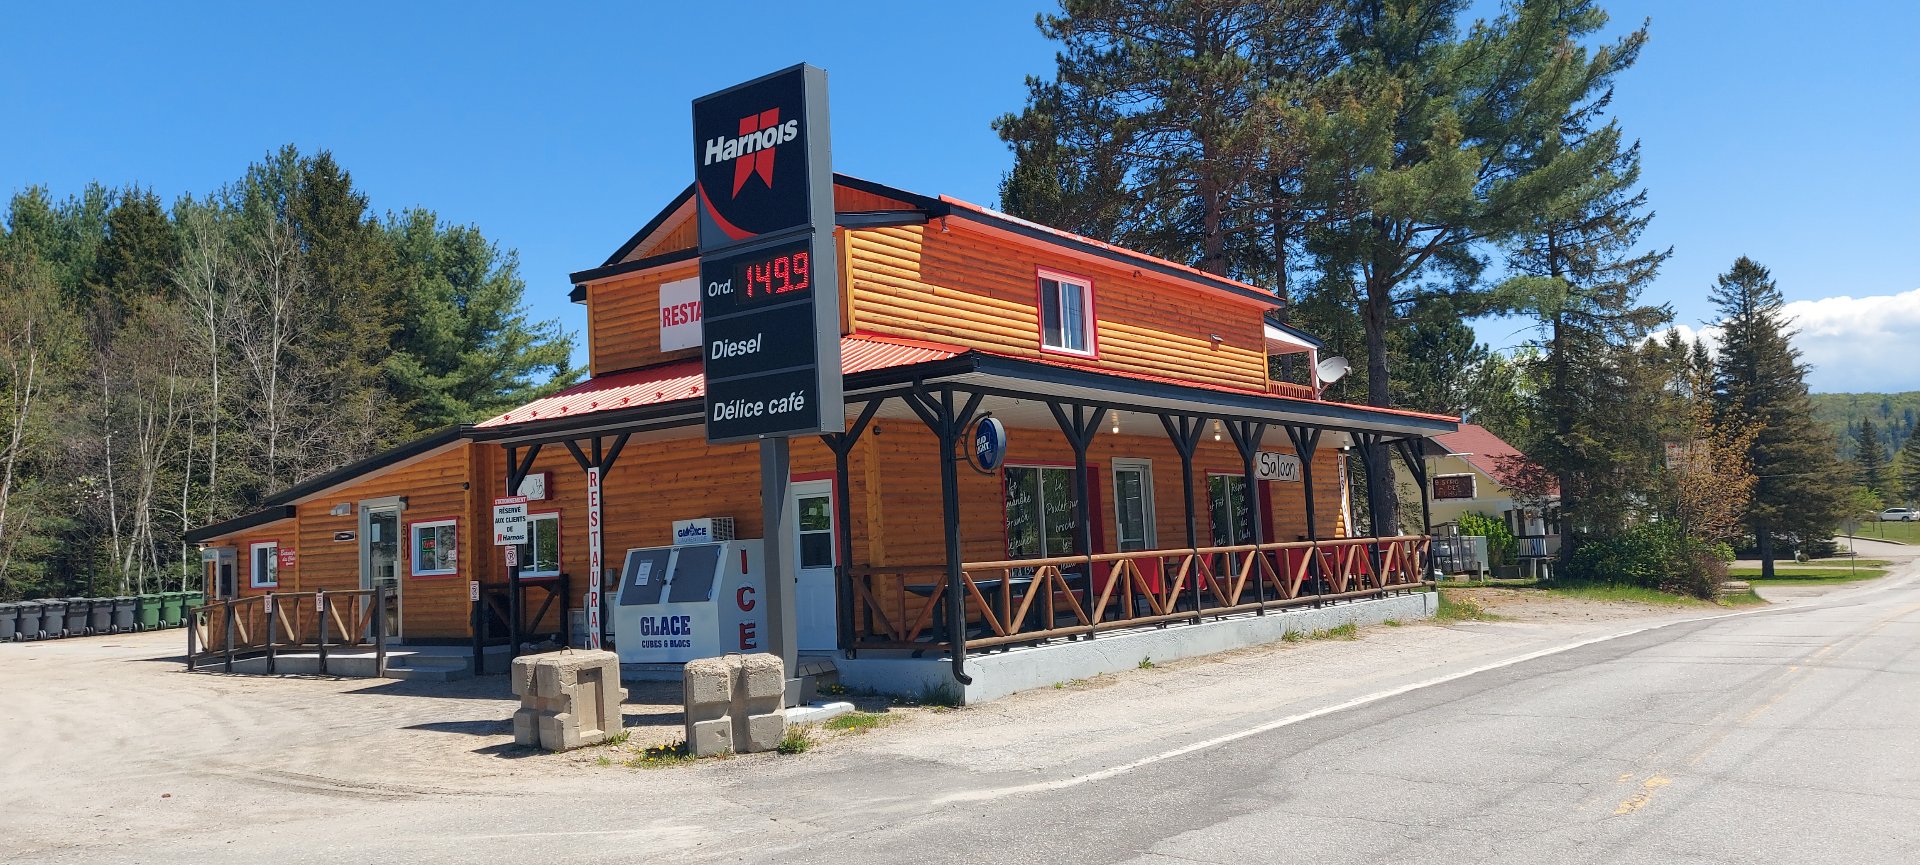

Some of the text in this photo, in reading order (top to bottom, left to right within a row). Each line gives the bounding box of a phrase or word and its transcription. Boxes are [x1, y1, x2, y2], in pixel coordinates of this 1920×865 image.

[704, 119, 798, 166] Harnois
[707, 278, 734, 297] Ord.
[662, 301, 703, 328] RESTA
[711, 332, 762, 360] Diesel
[713, 389, 805, 421] Délice café
[976, 441, 990, 455] IGHT
[1260, 452, 1296, 480] Saloon
[498, 505, 521, 514] RÉSERVÉ
[506, 515, 526, 523] CLIENTS
[506, 525, 513, 533] DE
[589, 471, 600, 649] RESTAURAN
[736, 549, 757, 651] ICE
[640, 615, 691, 637] GLACE
[641, 640, 662, 648] CUBES
[669, 639, 691, 648] BLOCS
